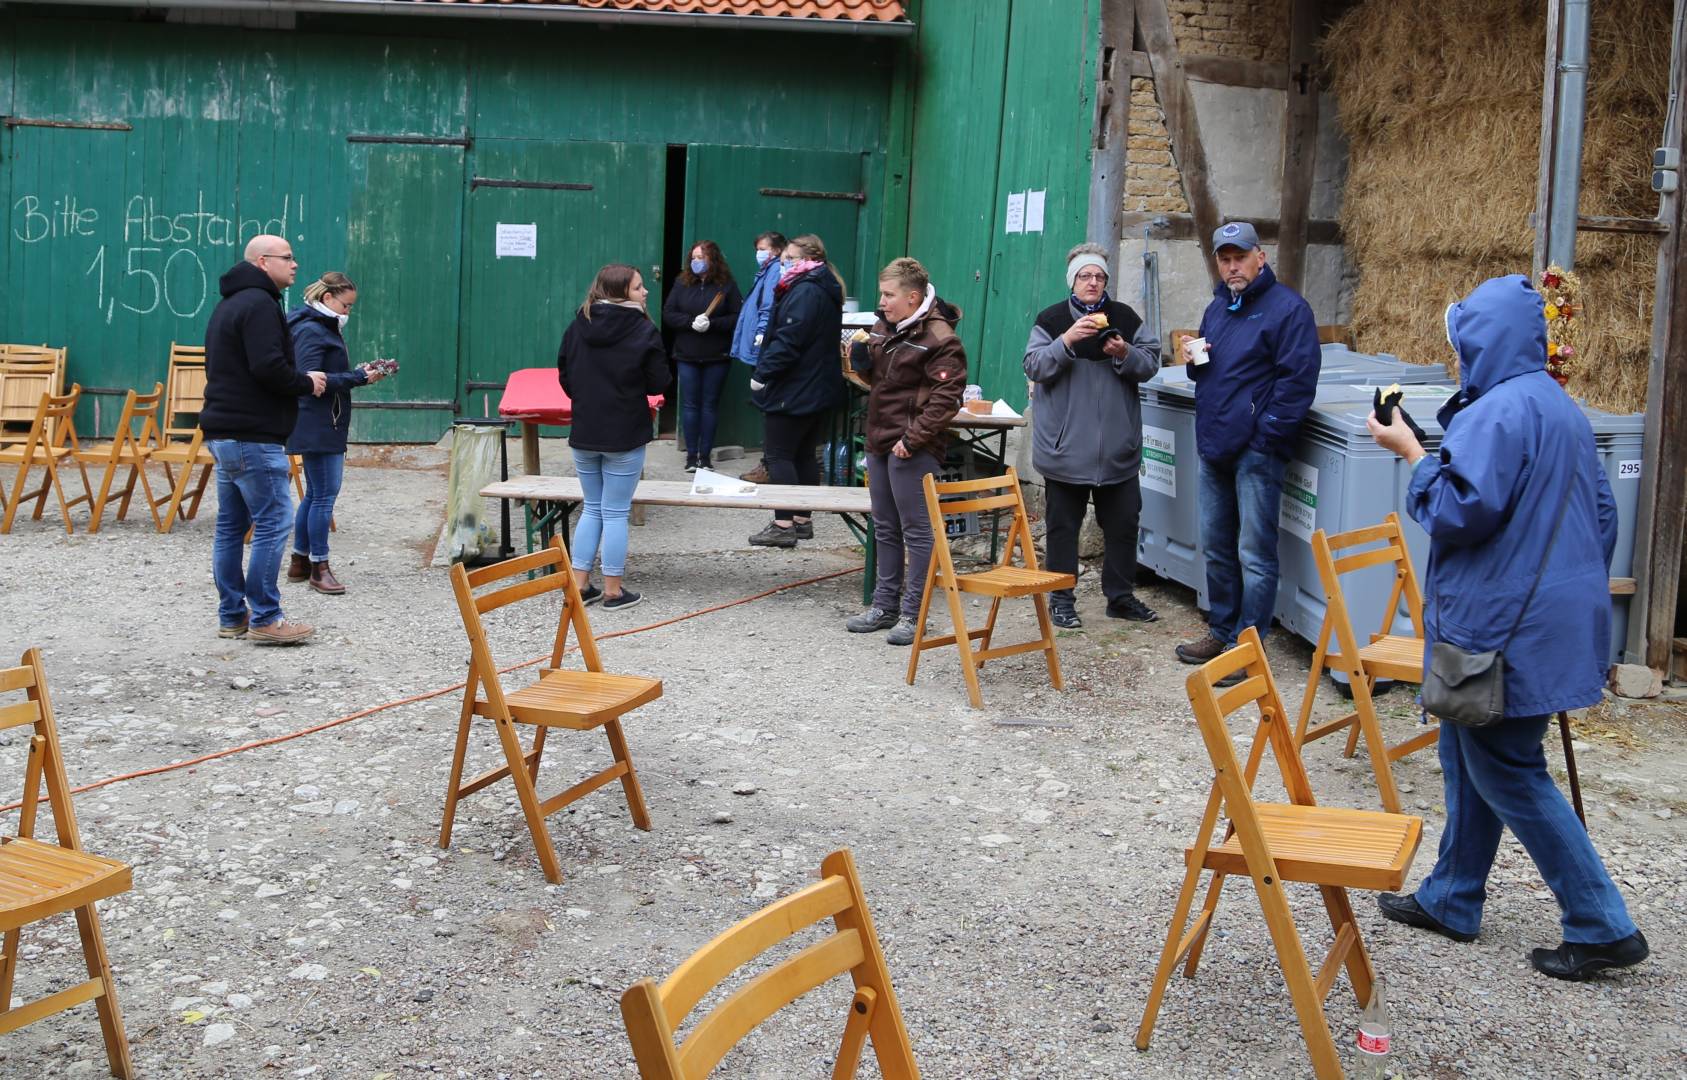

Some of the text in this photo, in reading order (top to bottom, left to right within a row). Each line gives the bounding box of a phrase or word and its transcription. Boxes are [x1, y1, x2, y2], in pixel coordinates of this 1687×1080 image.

[13, 190, 305, 247] Bitte Abstand!
[86, 245, 207, 325] 1,50
[1620, 463, 1640, 474] 295
